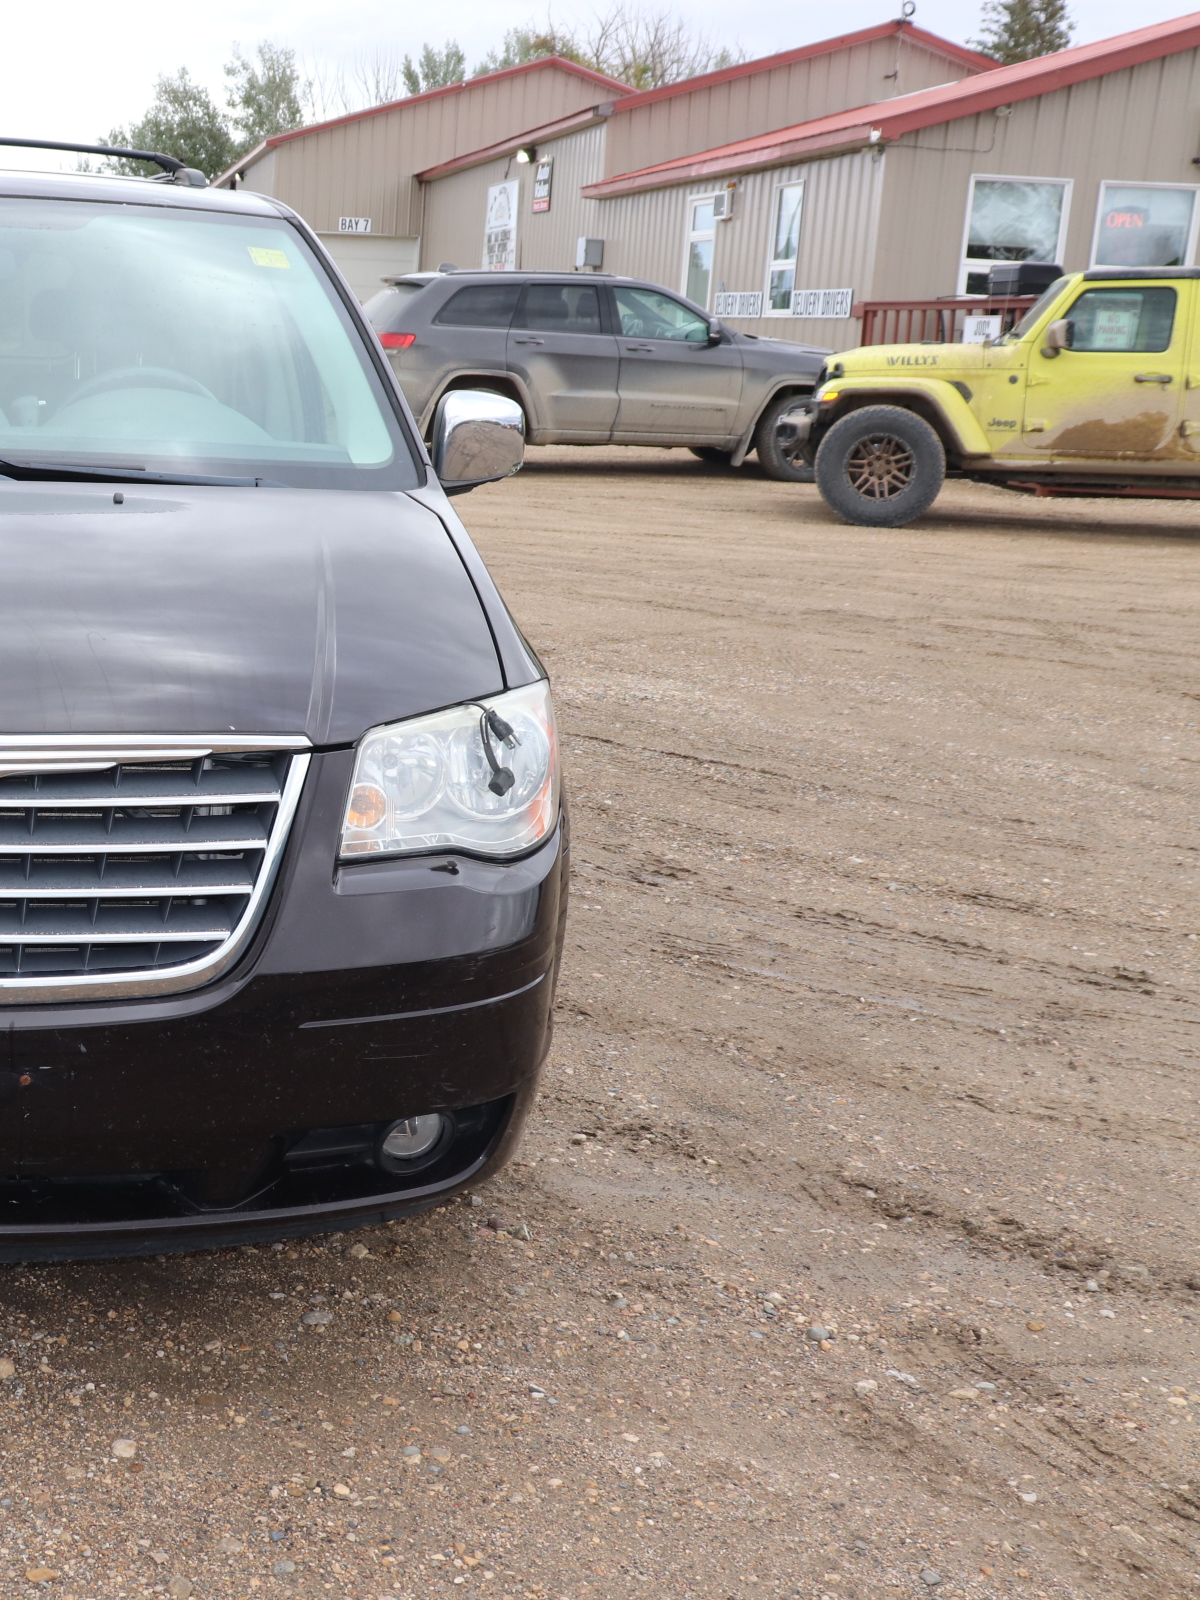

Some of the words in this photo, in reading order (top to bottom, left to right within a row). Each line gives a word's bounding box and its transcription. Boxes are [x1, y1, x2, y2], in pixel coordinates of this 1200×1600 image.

[341, 218, 360, 231] BAY
[364, 219, 369, 231] 7
[1106, 211, 1144, 228] OPEN
[715, 294, 737, 316] DELIVERY
[738, 293, 760, 316] DRIVERS
[793, 292, 821, 316] DELIVERY
[822, 290, 850, 316] DRIVERS
[886, 355, 939, 366] WILLYS
[987, 417, 1017, 429] Jeep
